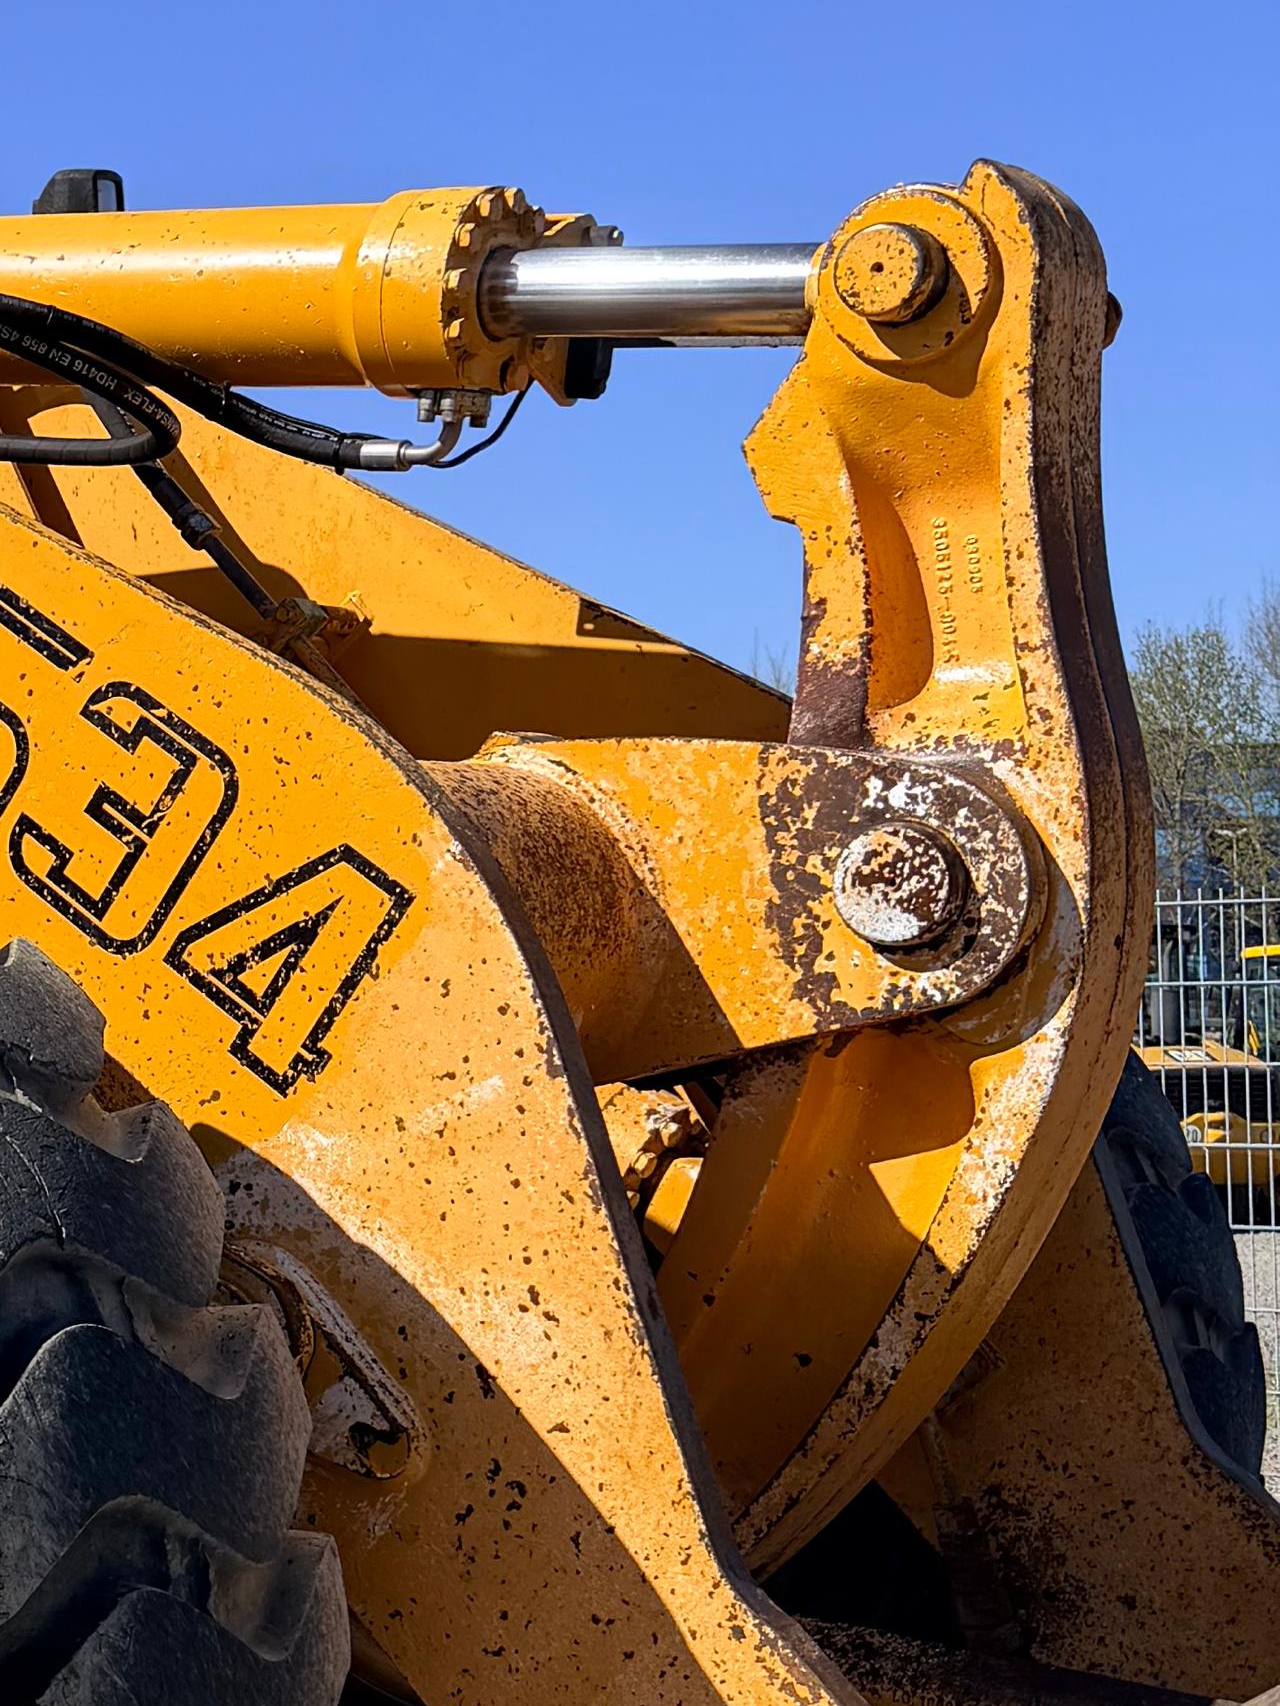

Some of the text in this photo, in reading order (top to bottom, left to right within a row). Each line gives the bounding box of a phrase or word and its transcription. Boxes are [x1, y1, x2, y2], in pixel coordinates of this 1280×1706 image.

[22, 335, 48, 354] 856
[49, 348, 72, 365] EN
[73, 358, 118, 390] HD416
